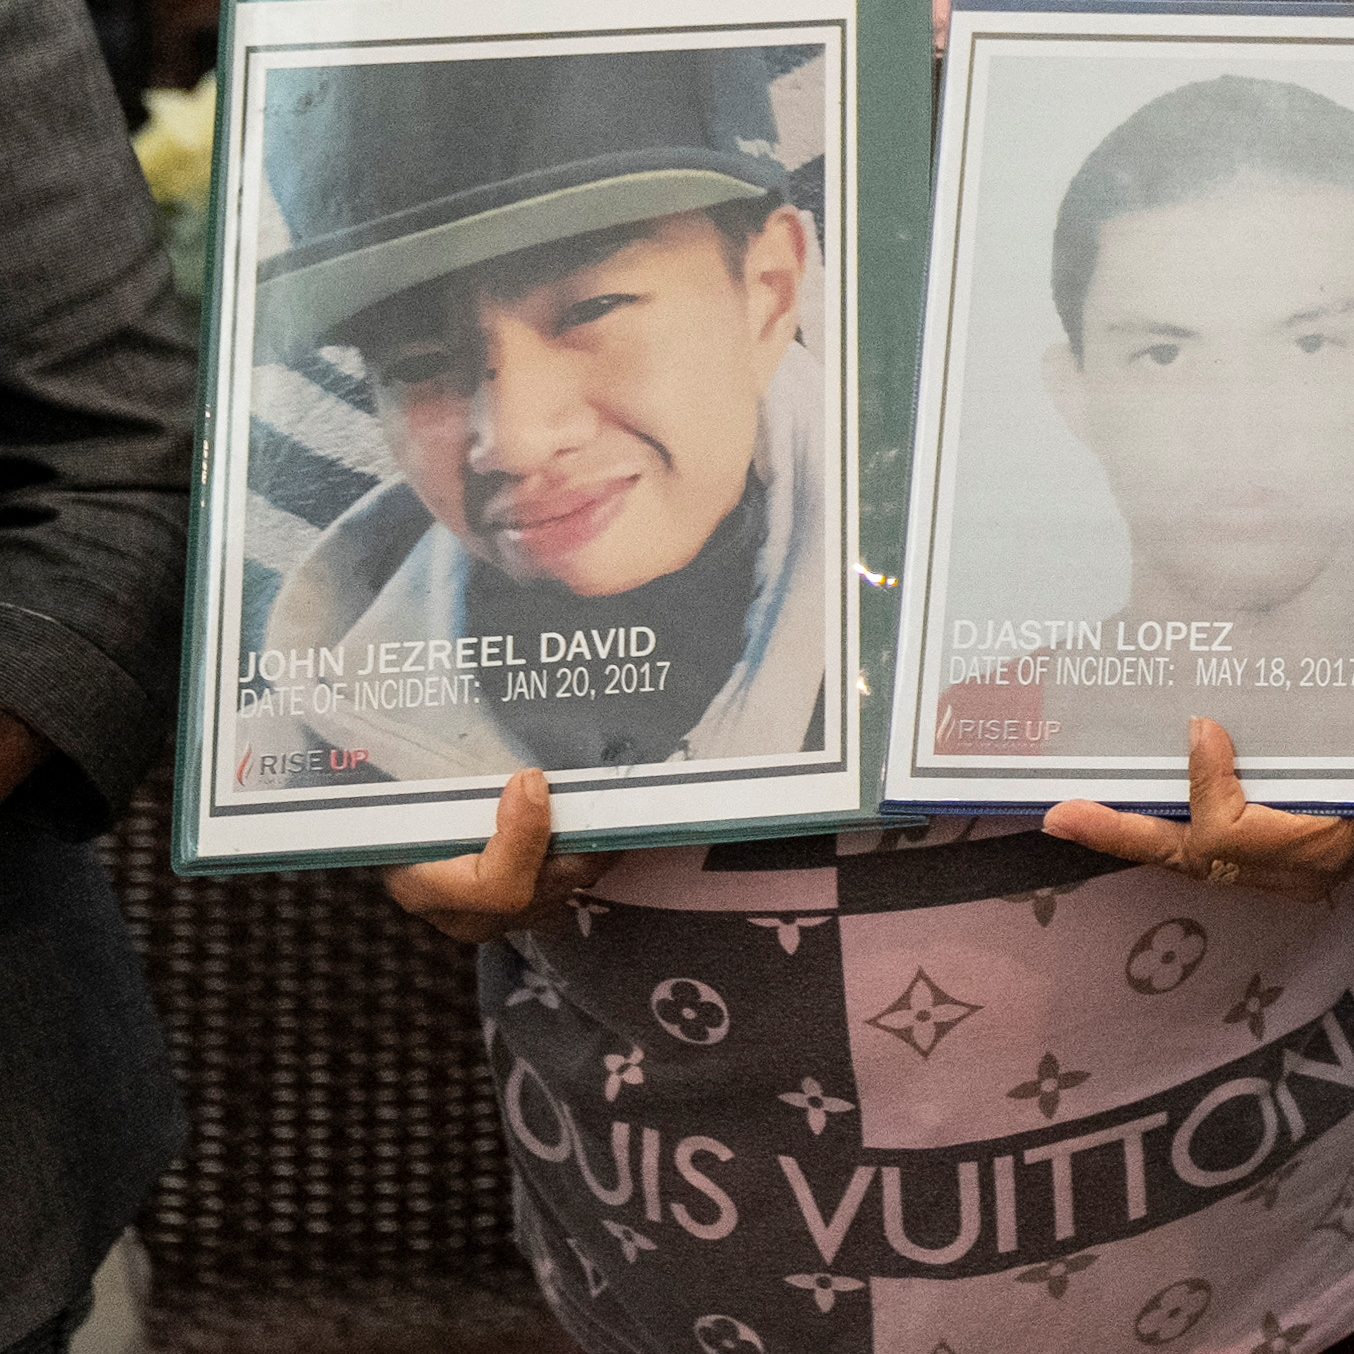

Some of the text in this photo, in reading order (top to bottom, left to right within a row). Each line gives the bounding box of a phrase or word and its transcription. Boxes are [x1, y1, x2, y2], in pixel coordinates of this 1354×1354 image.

[239, 625, 657, 683] JOHN JEZREEL DAVID
[953, 620, 1233, 652] DJASTIN LOPEZ
[240, 661, 672, 720] DATE OF INCIDENT: JAN 20, 2017
[949, 656, 1009, 686] DATE
[1016, 656, 1049, 686] OF
[1056, 656, 1175, 687] INCIDENT:
[1195, 657, 1247, 687] MAY
[1254, 658, 1293, 692] 18,
[1025, 720, 1061, 741] UP
[260, 749, 369, 775] RISE UP
[504, 1056, 738, 1241] OUIS
